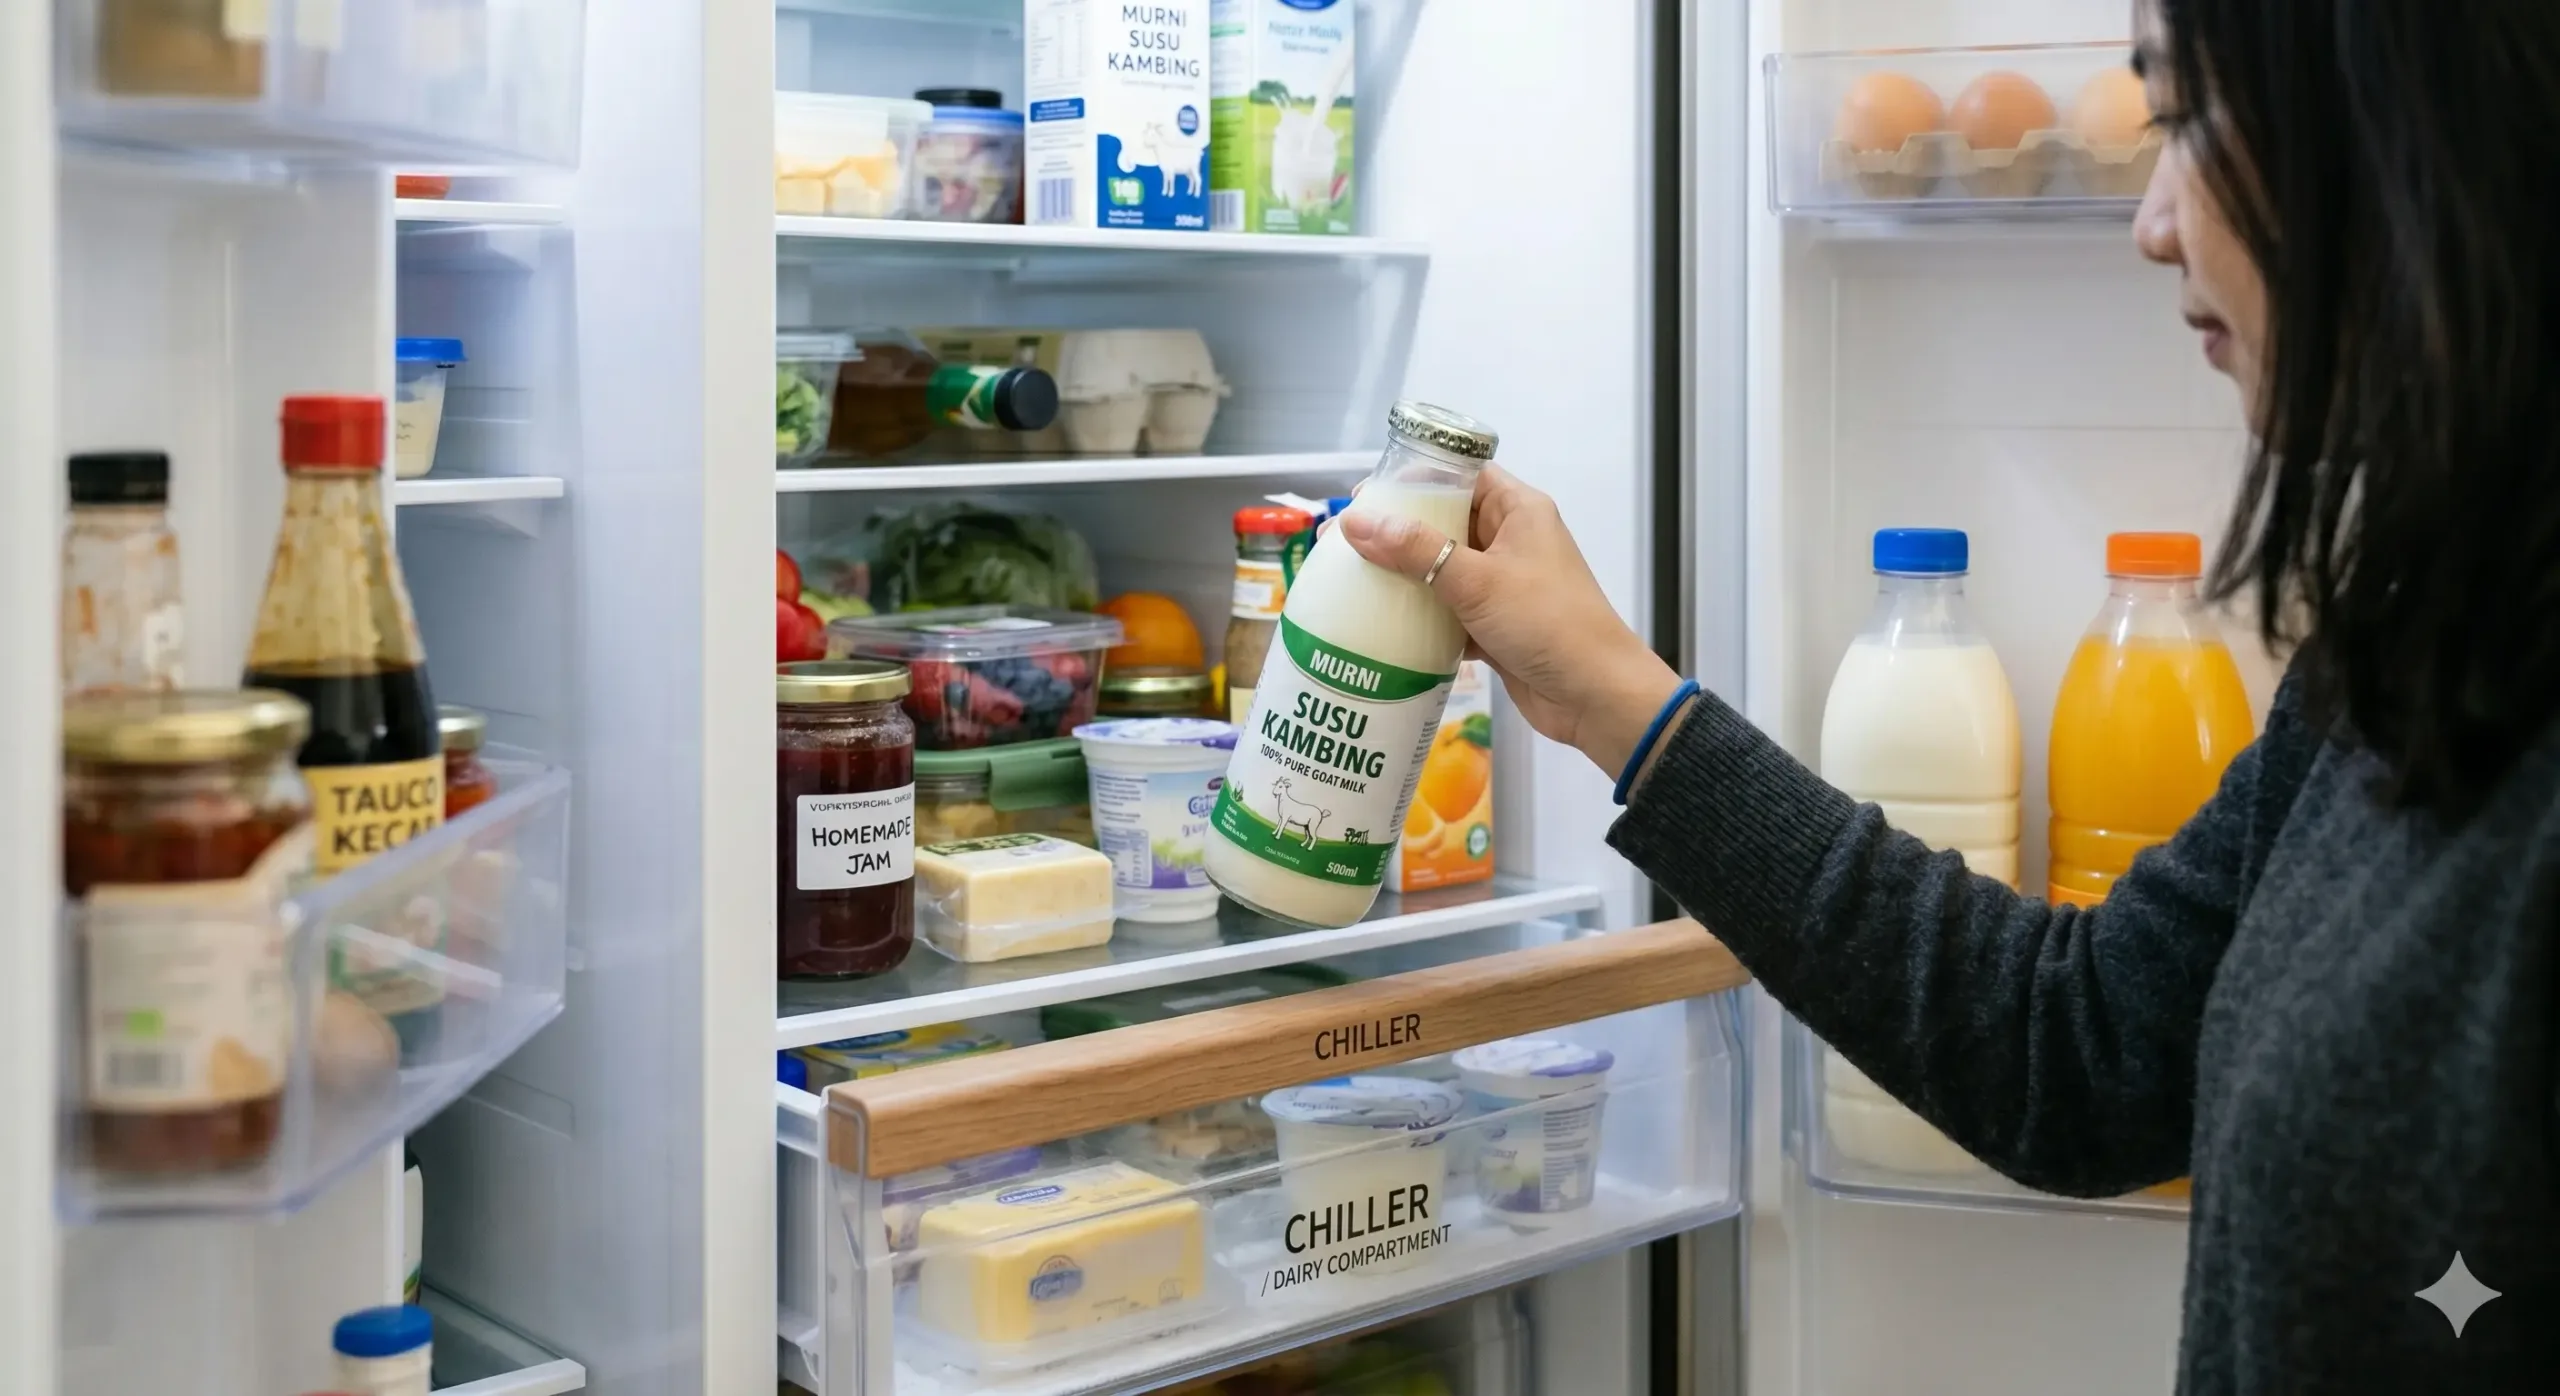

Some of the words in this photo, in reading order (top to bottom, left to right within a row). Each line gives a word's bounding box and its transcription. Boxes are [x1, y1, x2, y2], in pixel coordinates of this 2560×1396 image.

[1122, 4, 1187, 28] MURNI
[1129, 29, 1180, 51] SUSU
[1107, 51, 1200, 78] KAMBING
[1309, 648, 1382, 692] MURNI
[1292, 690, 1369, 740] SUSU
[1260, 708, 1386, 779] KAMBING
[1260, 743, 1283, 765] 100%
[1283, 757, 1311, 777] PURE
[1311, 769, 1341, 787] GOAT
[1339, 778, 1367, 794] MILK
[330, 776, 438, 816] TAUCO
[811, 815, 911, 847] HOMEMADE
[846, 850, 891, 875] JAM
[1325, 861, 1359, 878] 500ml
[1314, 1013, 1421, 1060] CHILLER
[1284, 1183, 1430, 1254] CHILLER
[1273, 1258, 1324, 1291] DAIRY
[1327, 1223, 1452, 1276] COMPARTMENT
